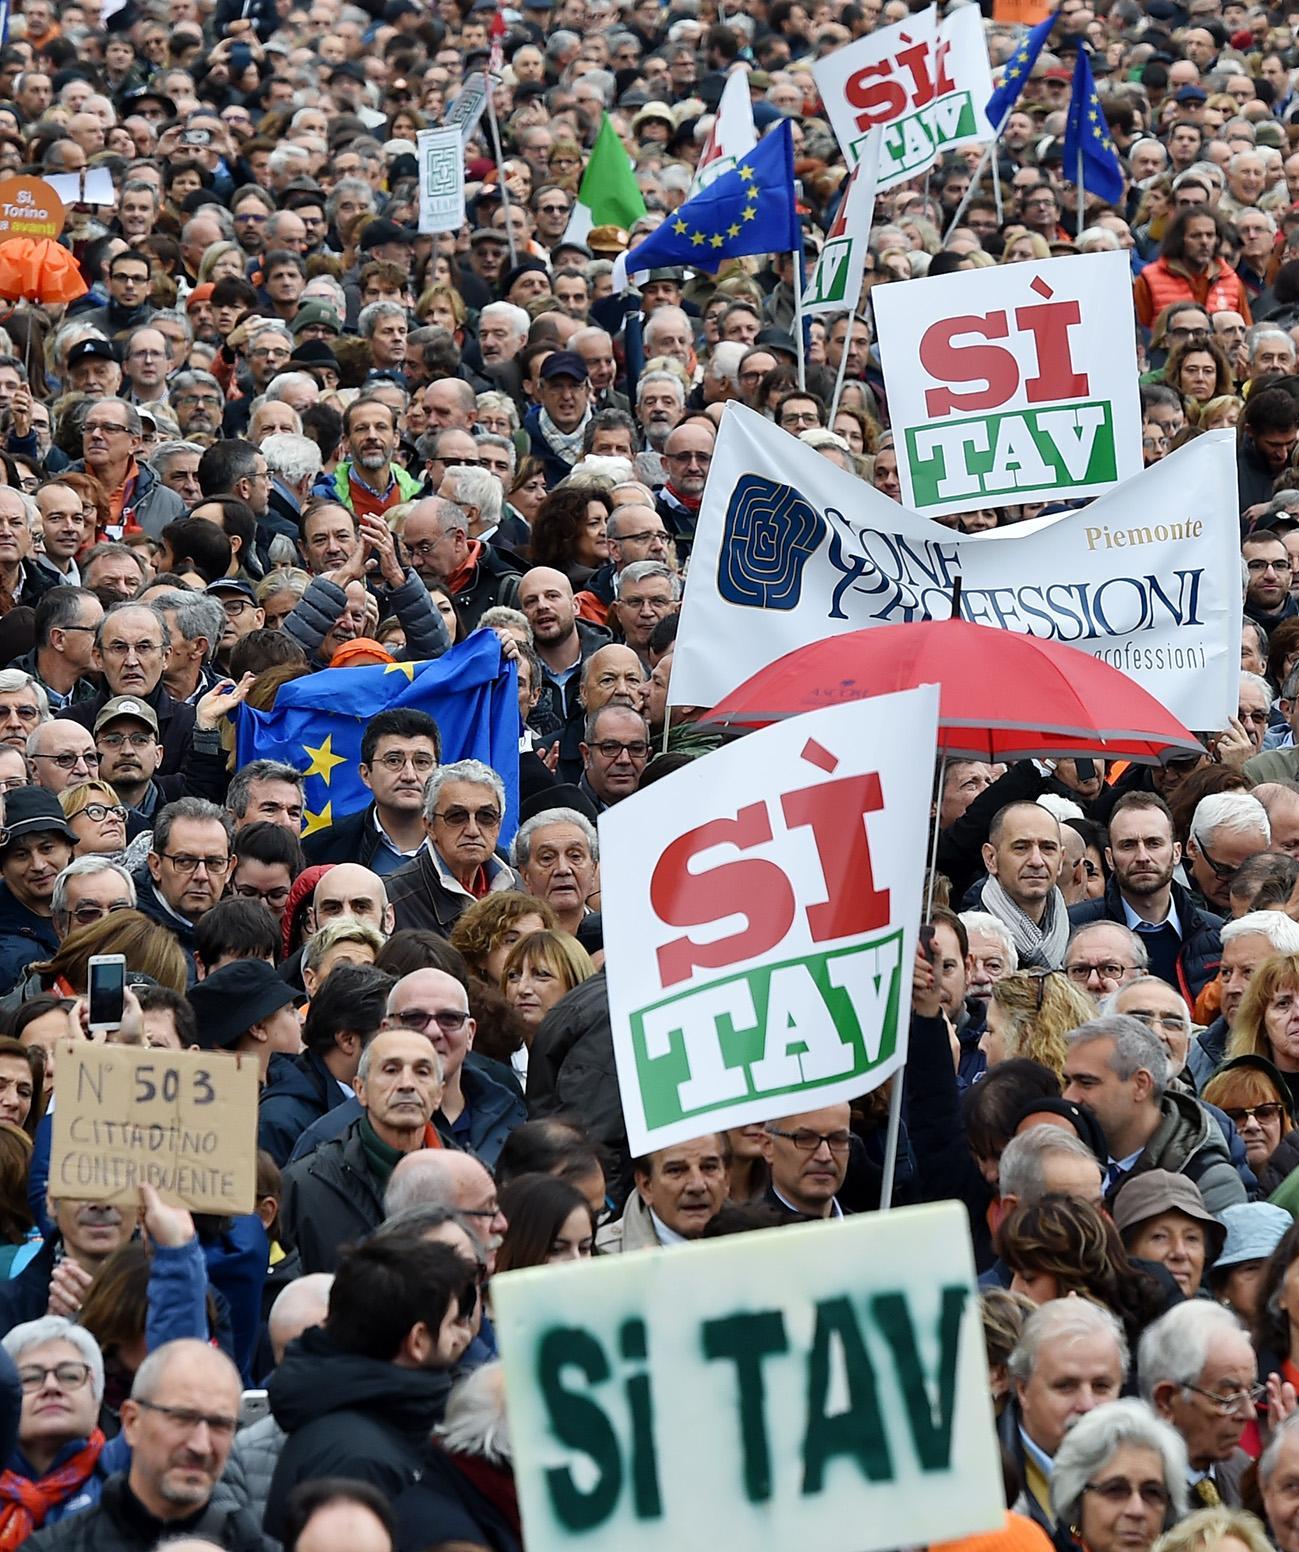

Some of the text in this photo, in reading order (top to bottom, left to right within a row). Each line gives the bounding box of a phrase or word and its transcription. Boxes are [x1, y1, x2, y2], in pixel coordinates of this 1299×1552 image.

[2, 202, 49, 220] Torino
[919, 275, 1090, 419] SÌ
[914, 405, 1106, 499] TAV
[824, 507, 962, 589] CONF
[1084, 516, 1203, 550] Piemonte
[827, 554, 1205, 643] PROFESSIONI
[650, 737, 890, 989] SÌ
[641, 936, 899, 1113] TAV
[135, 1066, 215, 1104] 503
[61, 1151, 236, 1197] CONTRIBUENTE
[70, 1115, 218, 1155] CITTADINO
[700, 1284, 970, 1506] TAV
